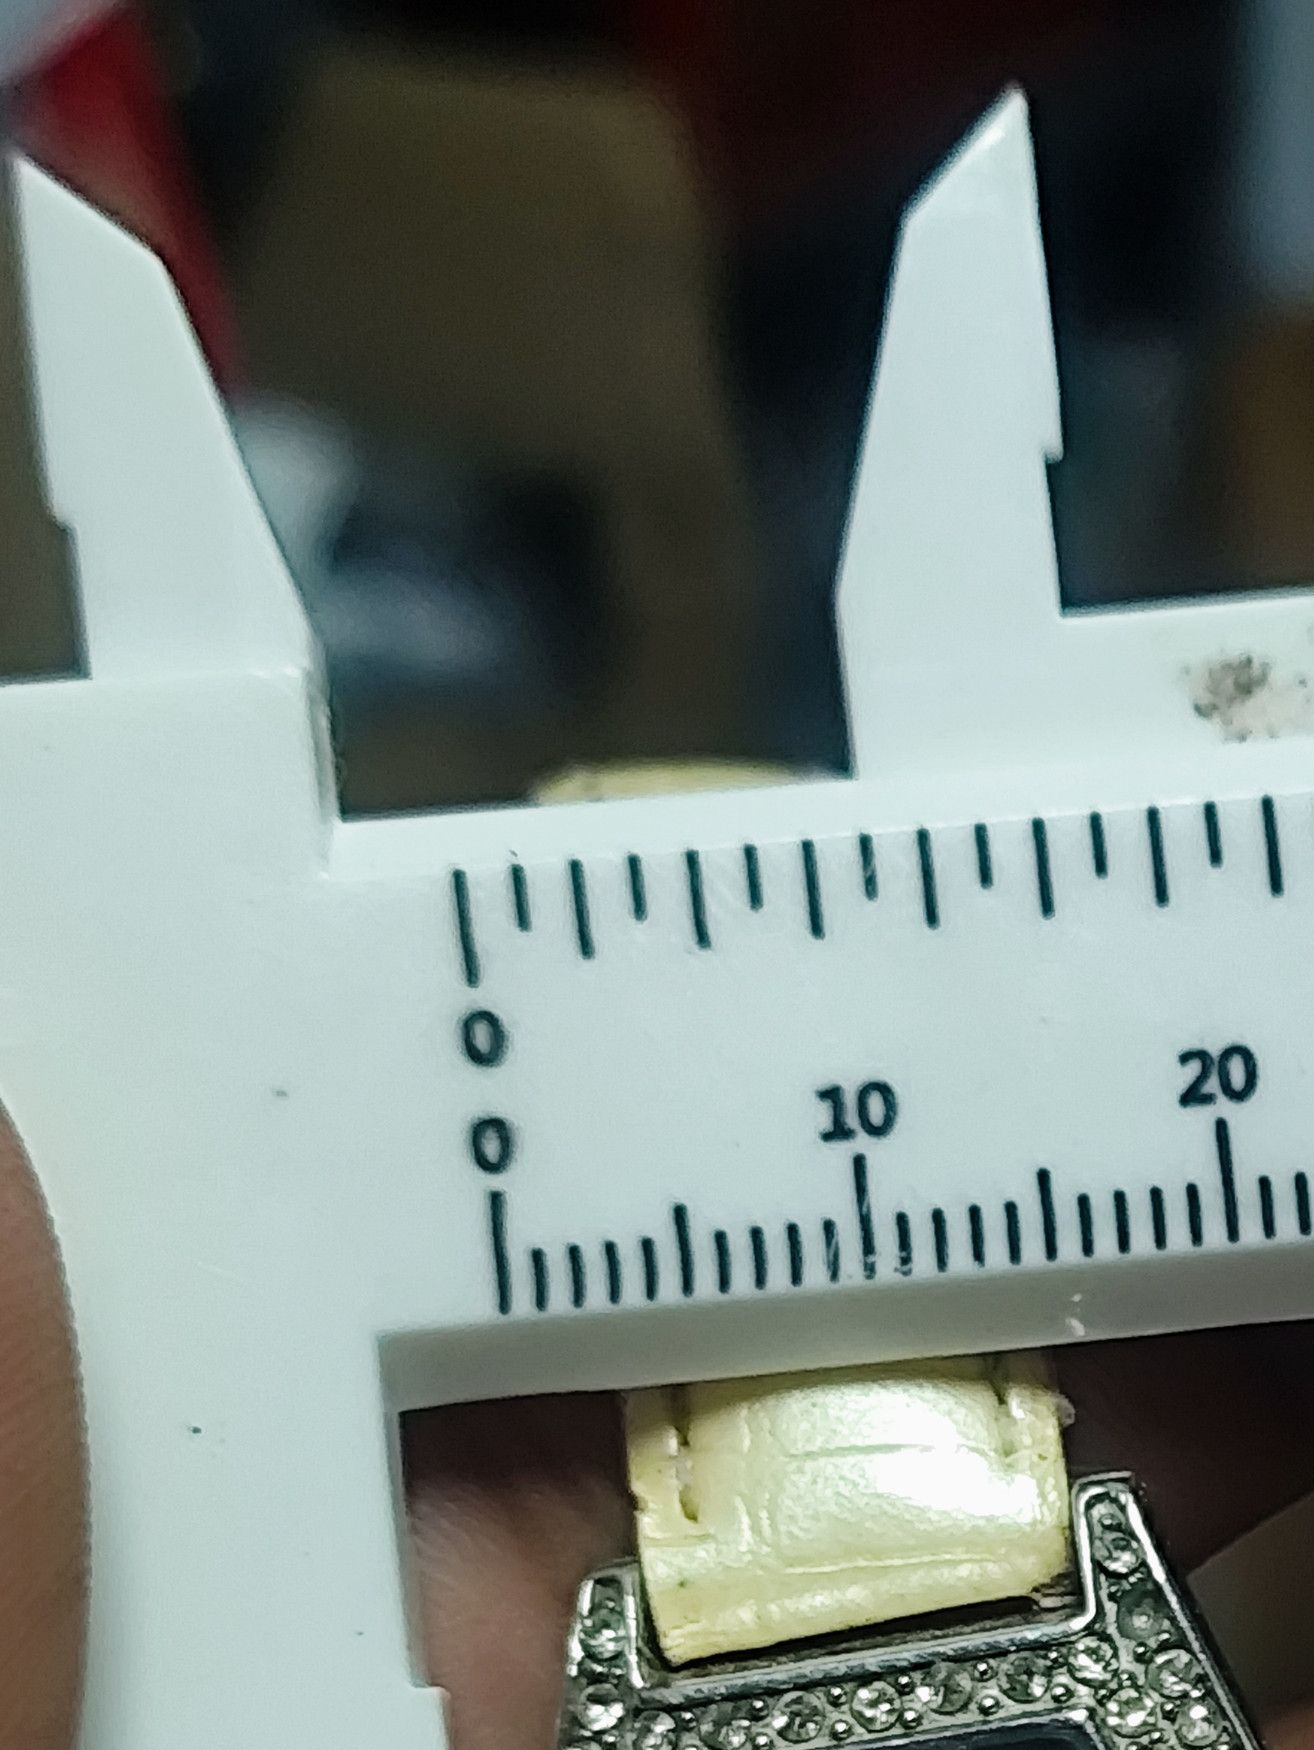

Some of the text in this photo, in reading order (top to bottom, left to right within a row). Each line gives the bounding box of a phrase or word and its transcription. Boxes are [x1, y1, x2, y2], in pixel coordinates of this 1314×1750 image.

[459, 1008, 508, 1069] 0
[468, 1115, 516, 1176] 0
[815, 1079, 899, 1144] 10
[1177, 1043, 1260, 1110] 20
